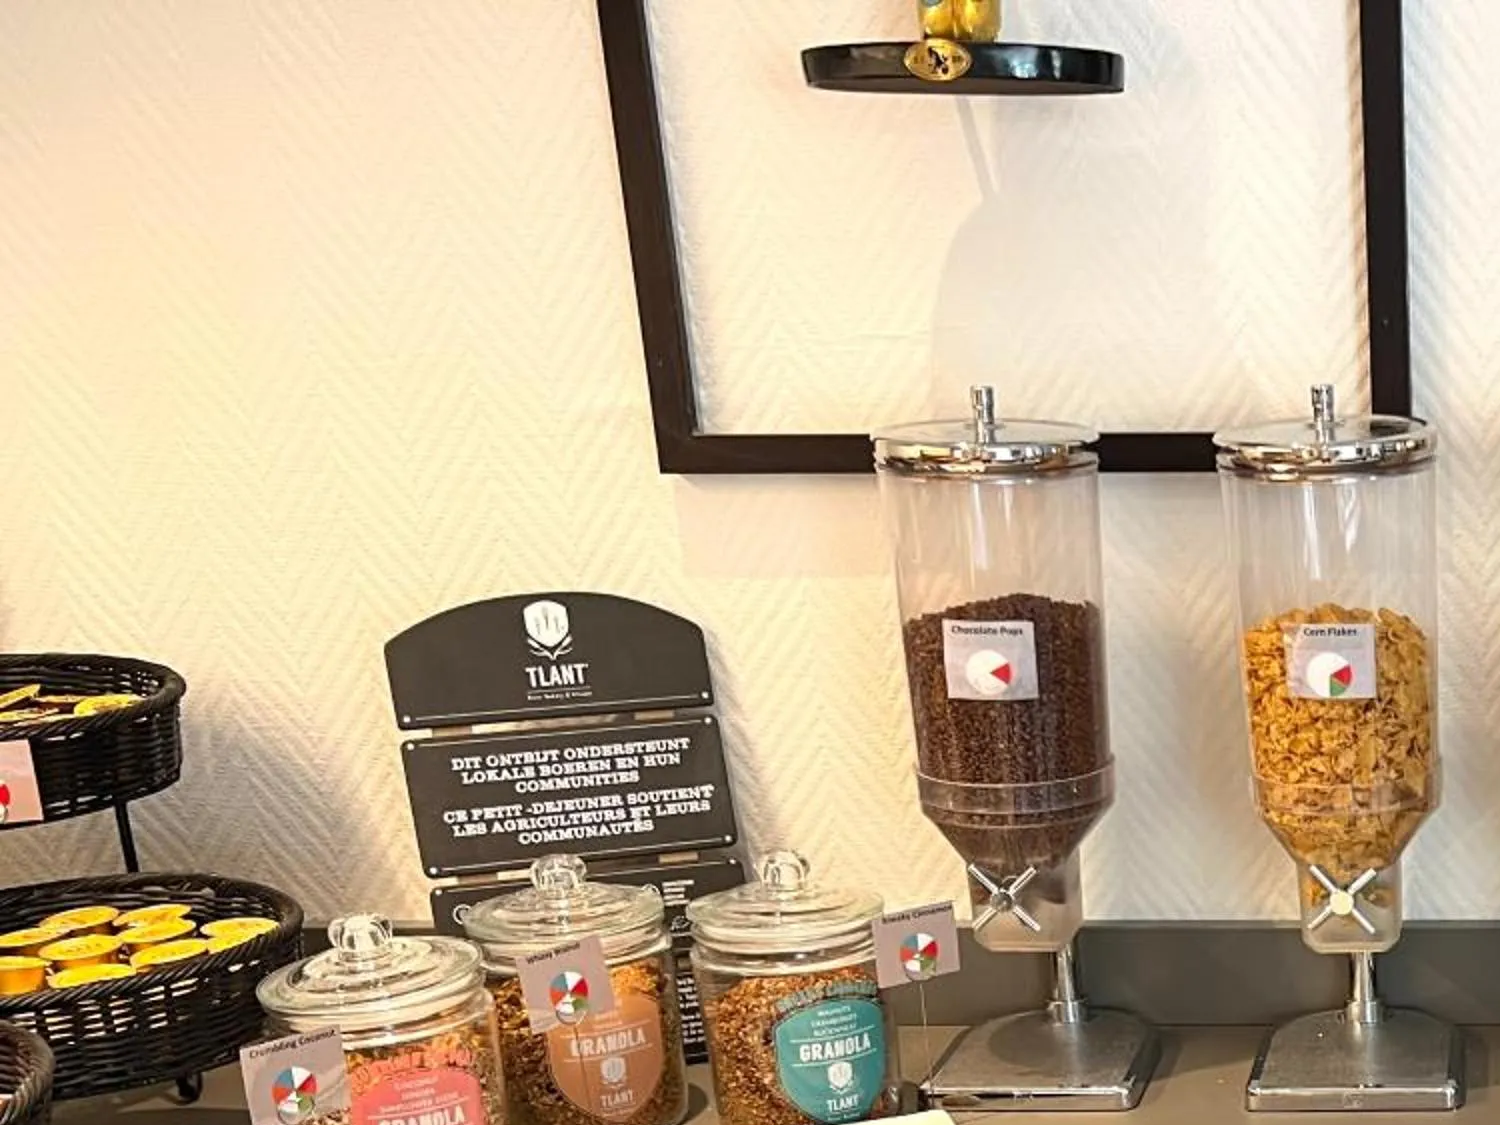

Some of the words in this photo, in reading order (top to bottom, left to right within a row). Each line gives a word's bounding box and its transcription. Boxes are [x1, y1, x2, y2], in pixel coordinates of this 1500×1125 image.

[1303, 627, 1326, 637] Corn
[1328, 627, 1358, 637] Flakes
[525, 663, 589, 689] TLANT
[451, 756, 483, 771] DIT
[486, 749, 560, 768] ONTBIJT
[564, 737, 690, 761] ONDERSTEUNT
[461, 767, 535, 785] LOKALE
[539, 759, 611, 776] BOEREN
[615, 755, 639, 769] EN
[643, 752, 681, 767] HUN
[515, 770, 640, 794] COMMUNITIES
[443, 810, 475, 824] CE
[478, 803, 523, 821] PETIT
[627, 784, 715, 805] SOUTIENT
[452, 822, 487, 838] LES
[491, 808, 626, 834] AGRICULTEURS
[631, 805, 652, 821] ET
[654, 799, 712, 817] LEURS
[569, 1026, 646, 1058] GRANOLA
[799, 1031, 872, 1063] GRANOLA
[827, 1094, 860, 1113] TLANT
